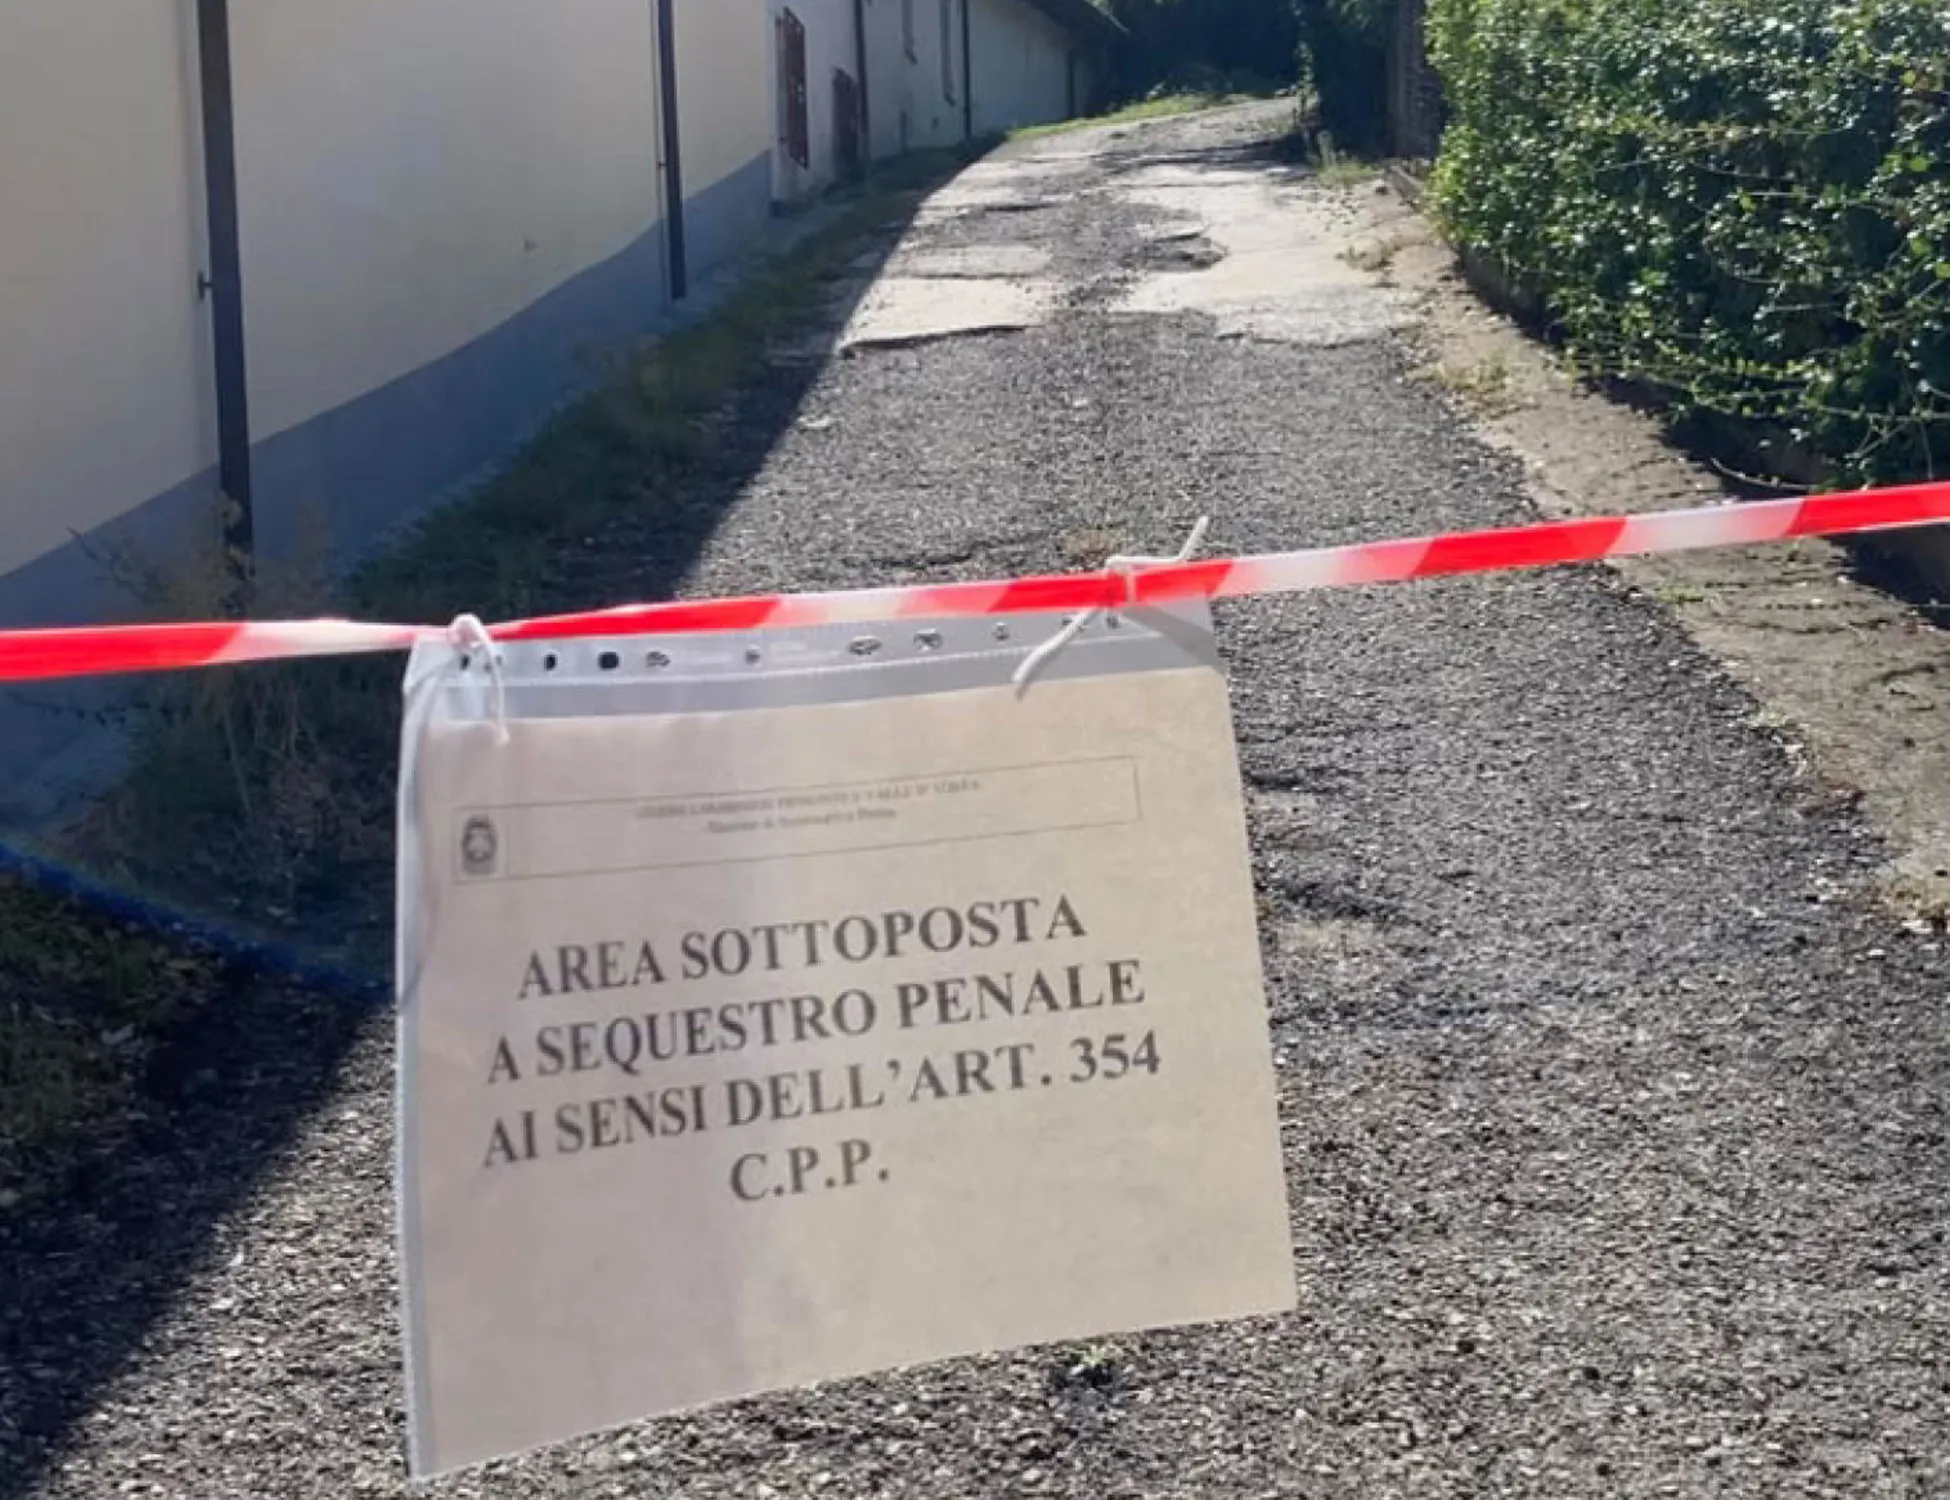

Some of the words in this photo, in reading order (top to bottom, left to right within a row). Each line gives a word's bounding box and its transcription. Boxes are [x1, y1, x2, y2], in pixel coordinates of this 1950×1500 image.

[518, 940, 666, 999] AREA
[680, 895, 1087, 980] SOTTOPOSTA
[487, 1037, 521, 1083] A
[535, 988, 877, 1076] SEQUESTRO
[895, 959, 1145, 1029] PENALE
[484, 1111, 537, 1168] AI
[554, 1083, 707, 1152] SENSI
[724, 1043, 1053, 1127] DELL'ART.
[1068, 1029, 1161, 1083] 354
[729, 1139, 889, 1202] C.P.P.
